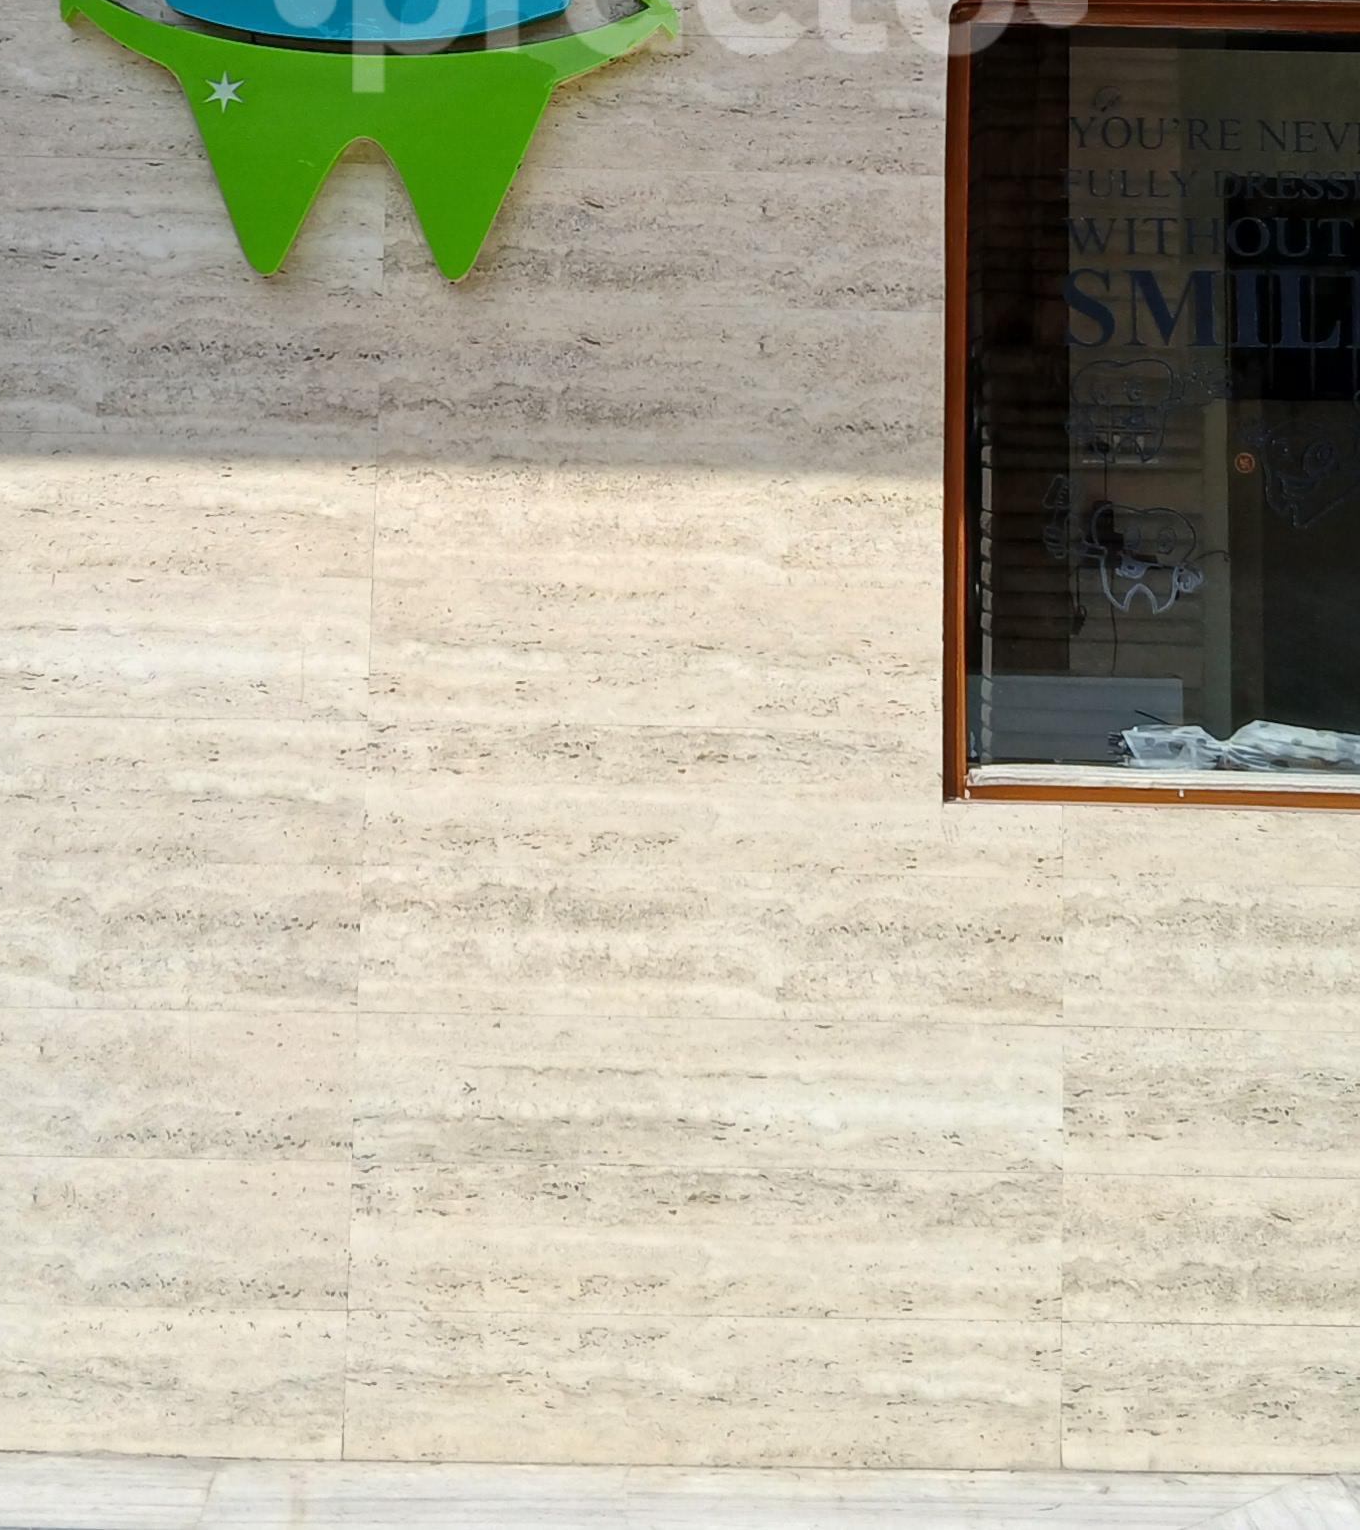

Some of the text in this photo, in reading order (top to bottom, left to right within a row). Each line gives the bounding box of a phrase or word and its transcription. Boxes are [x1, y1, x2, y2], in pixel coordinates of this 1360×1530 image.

[1068, 115, 1242, 151] YOU'RE
[1060, 167, 1198, 200] FULLY
[1063, 217, 1355, 258] WITHOUT
